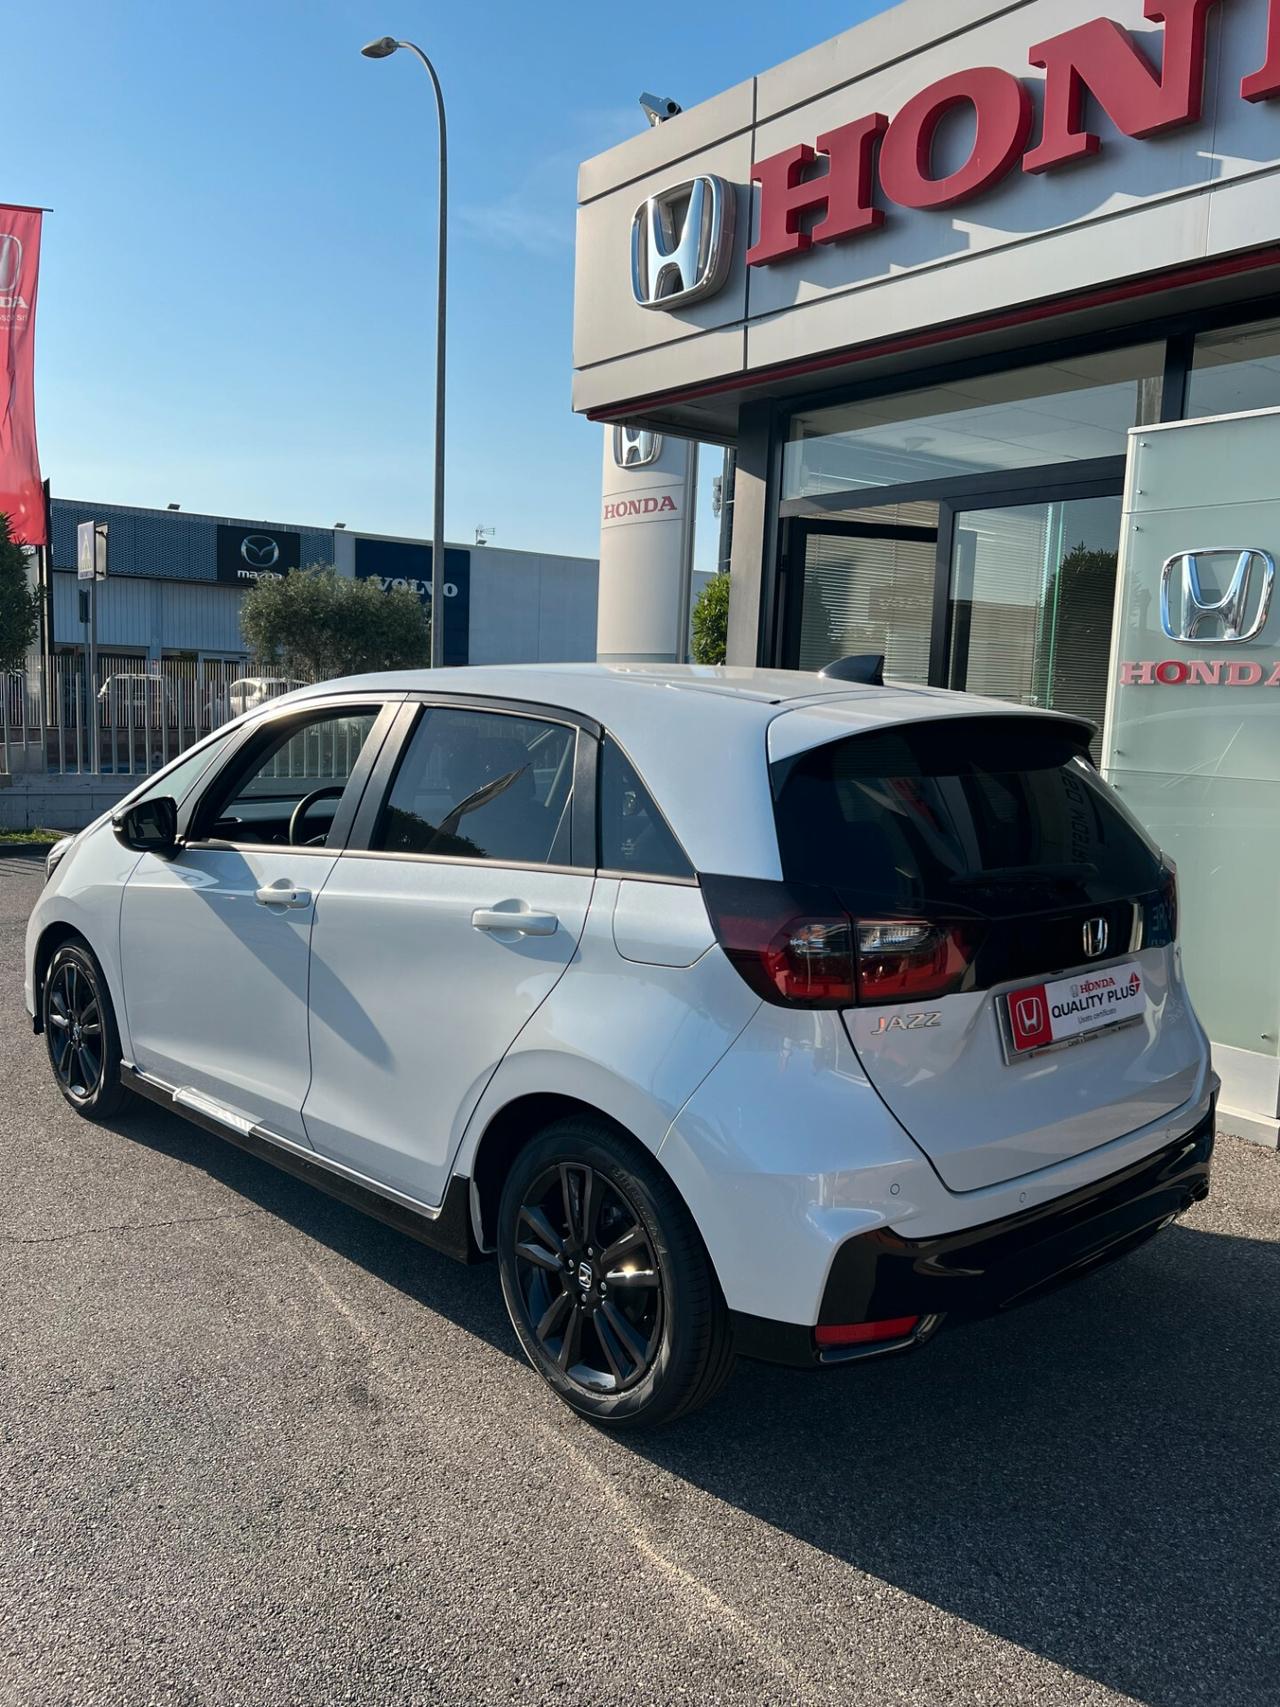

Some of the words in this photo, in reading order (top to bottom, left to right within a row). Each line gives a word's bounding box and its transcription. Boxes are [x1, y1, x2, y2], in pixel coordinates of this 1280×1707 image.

[746, 0, 1280, 267] HON
[604, 495, 677, 520] HONDA
[1079, 977, 1116, 994] HONDA
[1051, 992, 1105, 1019] QUALITY
[1107, 984, 1137, 1004] PLUS
[871, 1011, 942, 1035] JAZZ
